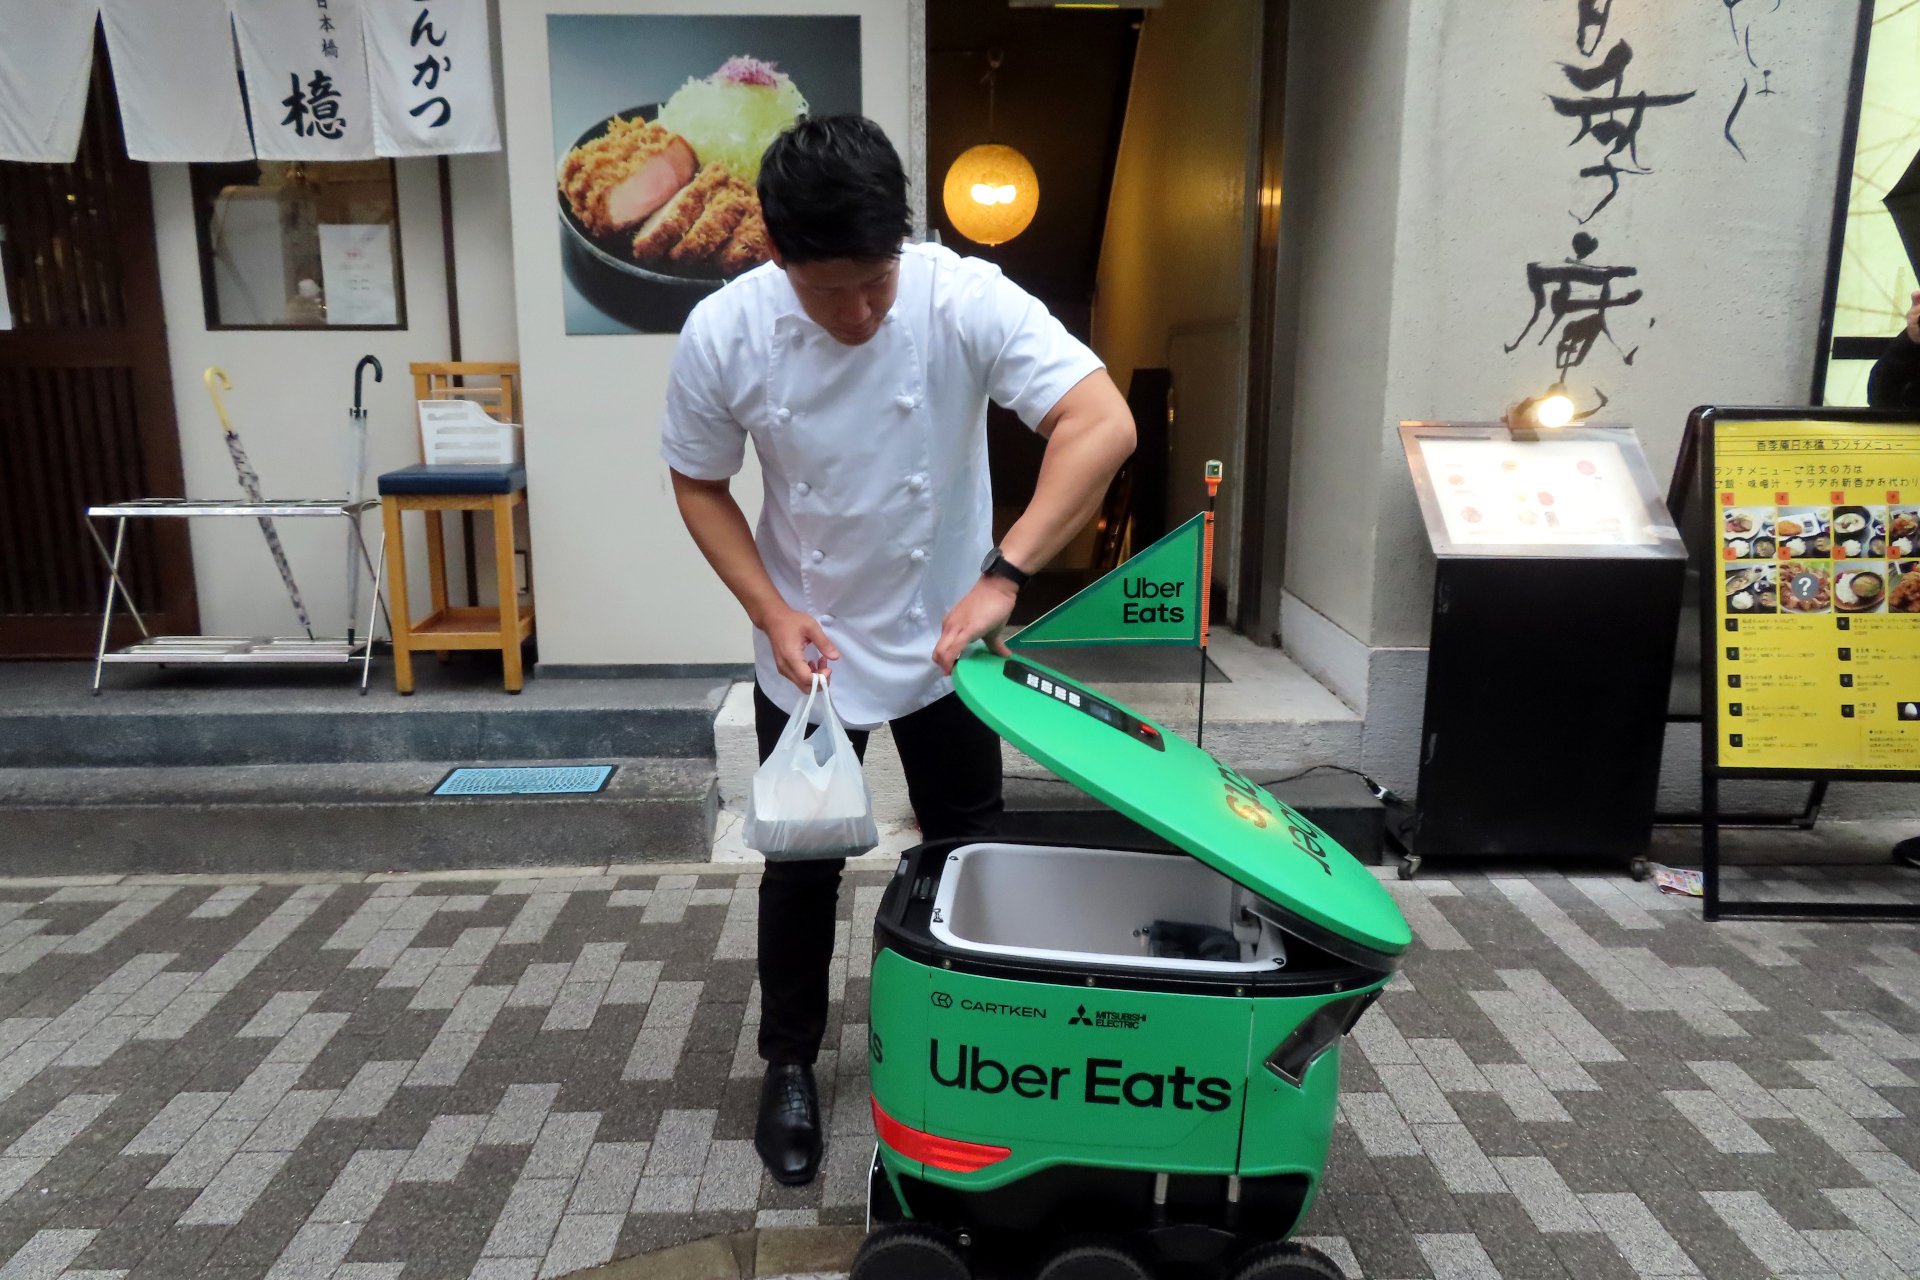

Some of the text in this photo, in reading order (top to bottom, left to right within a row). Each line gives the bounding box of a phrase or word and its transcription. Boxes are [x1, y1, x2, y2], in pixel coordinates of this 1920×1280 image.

[410, 0, 452, 128] んかつ
[1831, 440, 1904, 451] ランチメニュー
[1123, 577, 1185, 599] Uber
[1123, 602, 1185, 624] Eats
[961, 998, 1047, 1019] CARTKEN
[1095, 1011, 1147, 1022] MITSUBISHI
[1095, 1019, 1140, 1030] ELECTRIC
[930, 1038, 1232, 1113] Uber Eats
